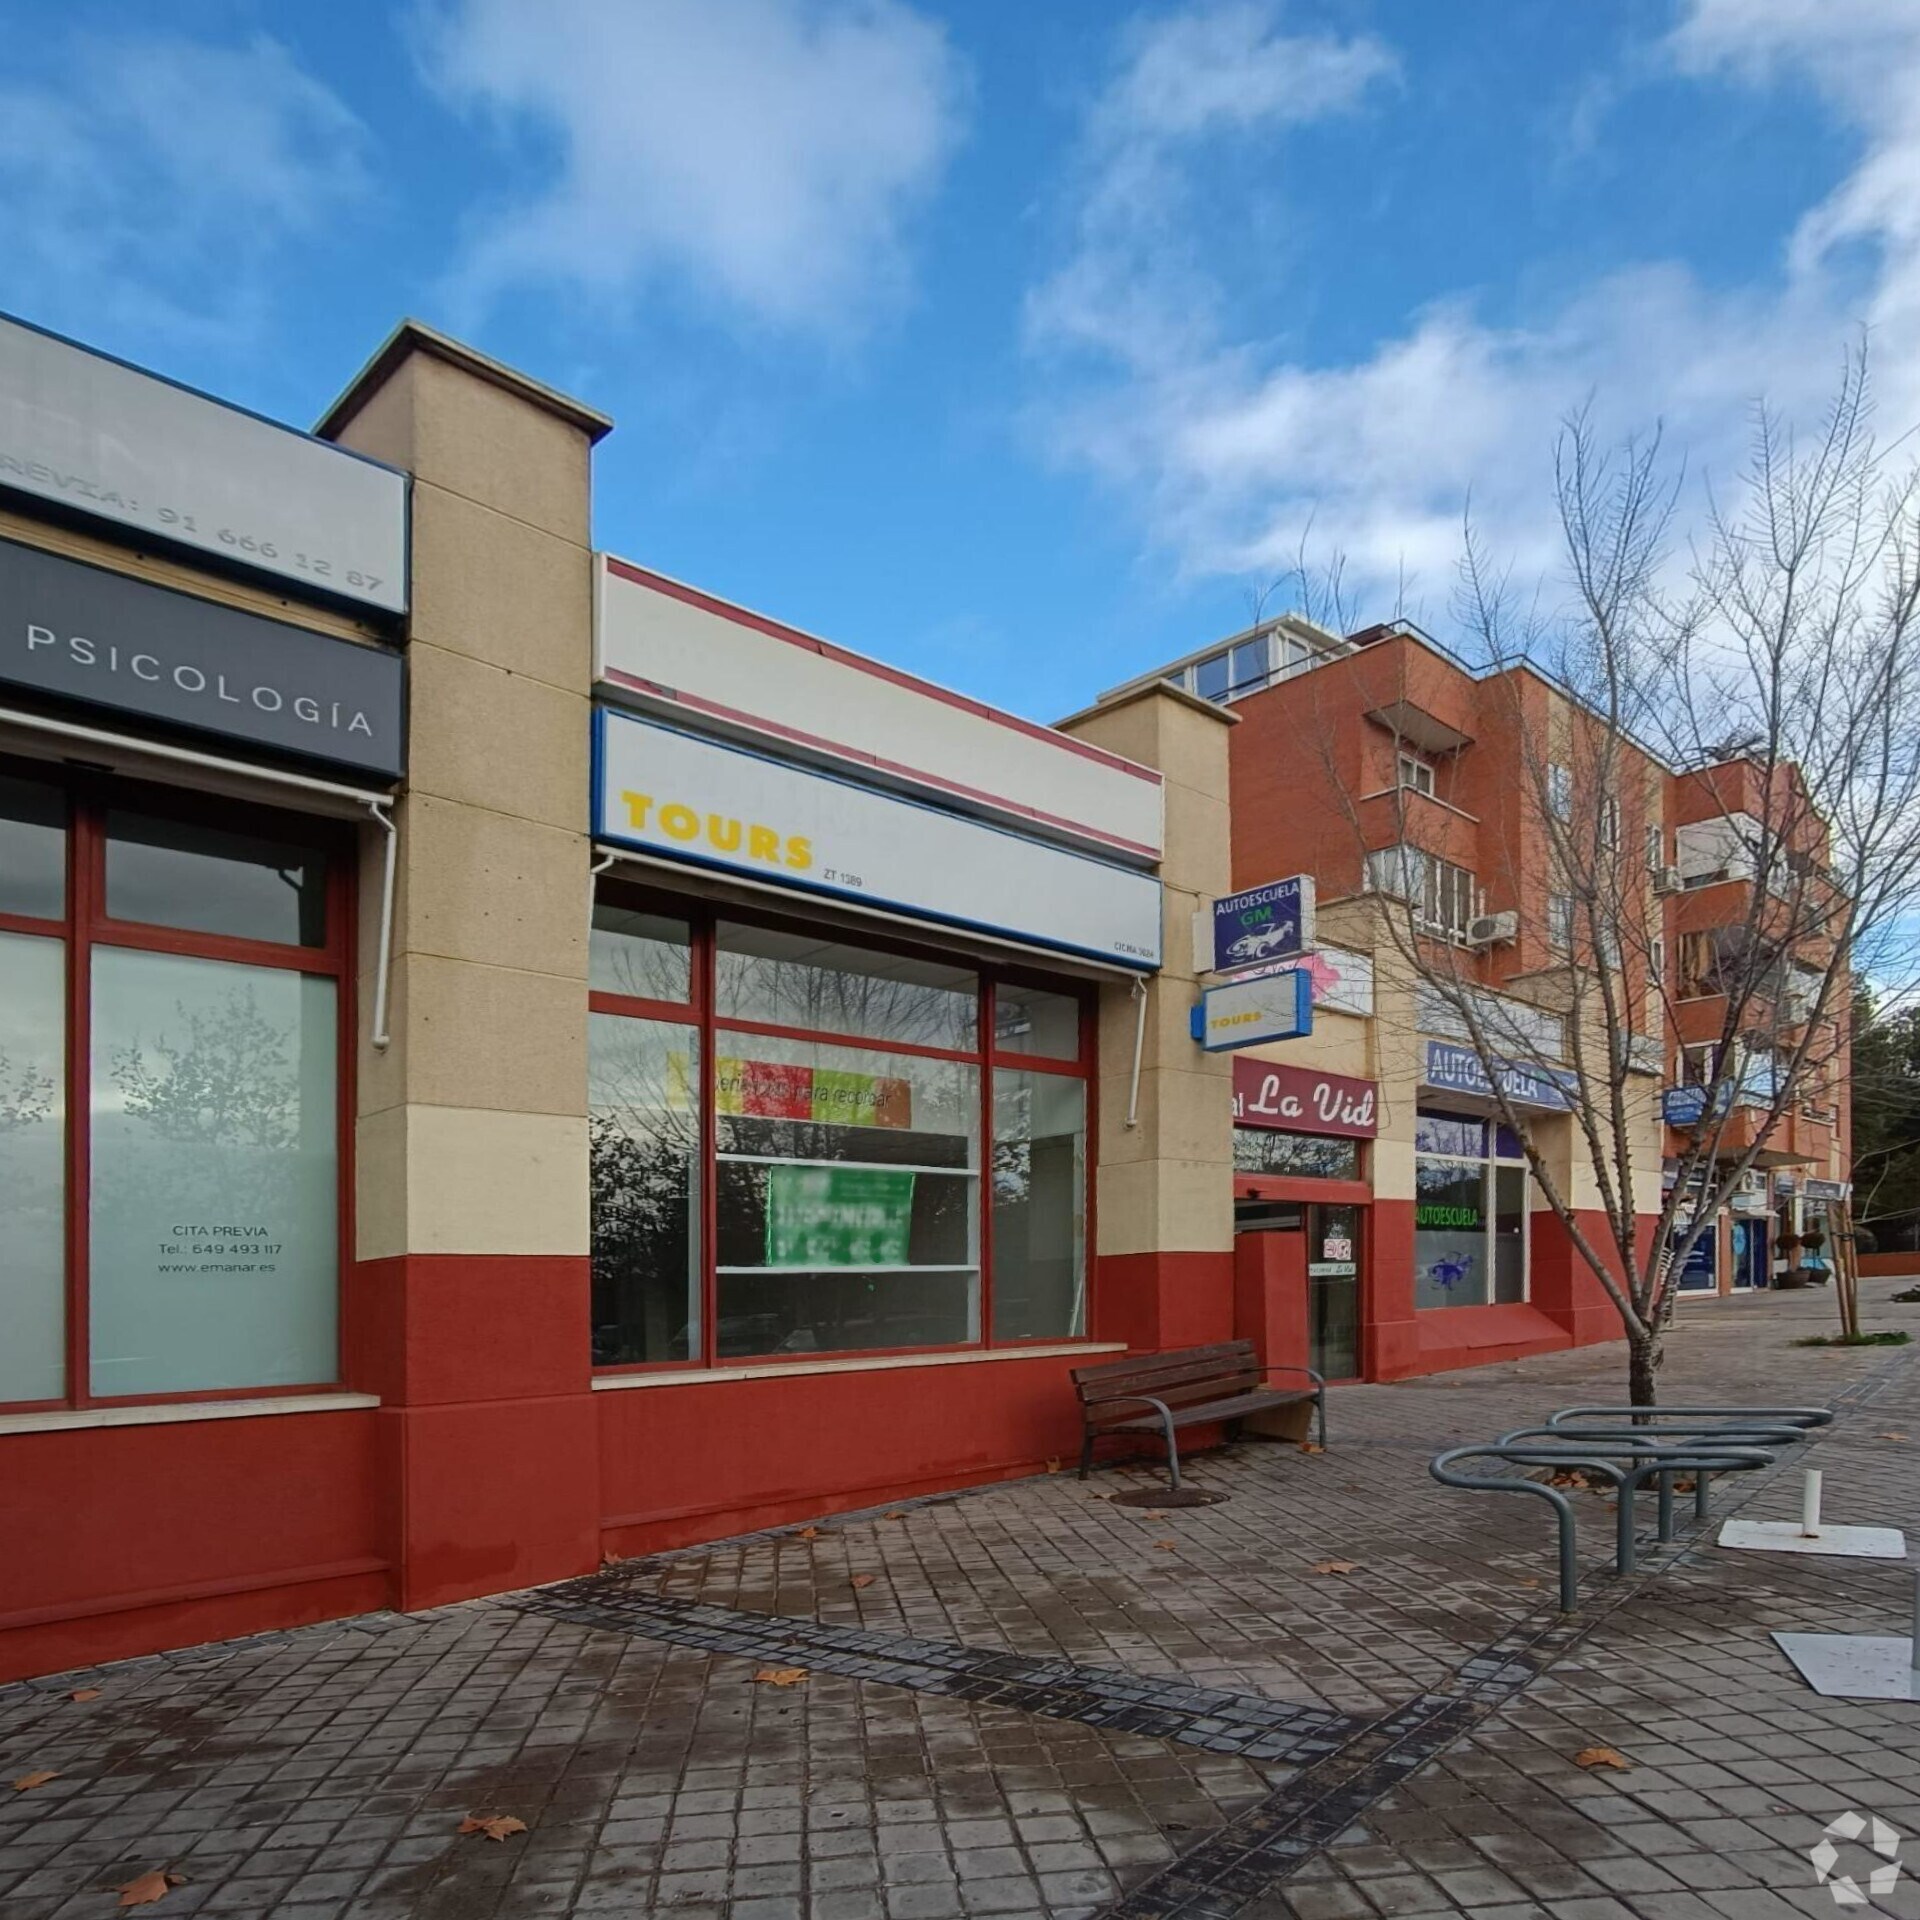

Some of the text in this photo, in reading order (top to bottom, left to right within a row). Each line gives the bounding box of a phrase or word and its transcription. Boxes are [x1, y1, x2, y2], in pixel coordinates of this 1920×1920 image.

[158, 508, 197, 532] 91
[218, 528, 278, 559] 666
[295, 554, 332, 576] 12
[346, 571, 383, 591] 87
[27, 625, 372, 736] PSICOLOGÍA
[622, 790, 813, 870] TOURS
[824, 869, 838, 881] ZT
[1216, 881, 1300, 916] AUTOESCUELA
[1240, 906, 1273, 927] GM
[1210, 1011, 1263, 1029] TOURS
[1248, 1074, 1304, 1118] La
[1313, 1083, 1375, 1126] Vid
[1415, 1206, 1477, 1226] AUTOESCUELA
[172, 1225, 269, 1237] CITA PREVIA
[192, 1244, 224, 1255] 649
[229, 1244, 260, 1255] 493
[264, 1244, 283, 1254] 117
